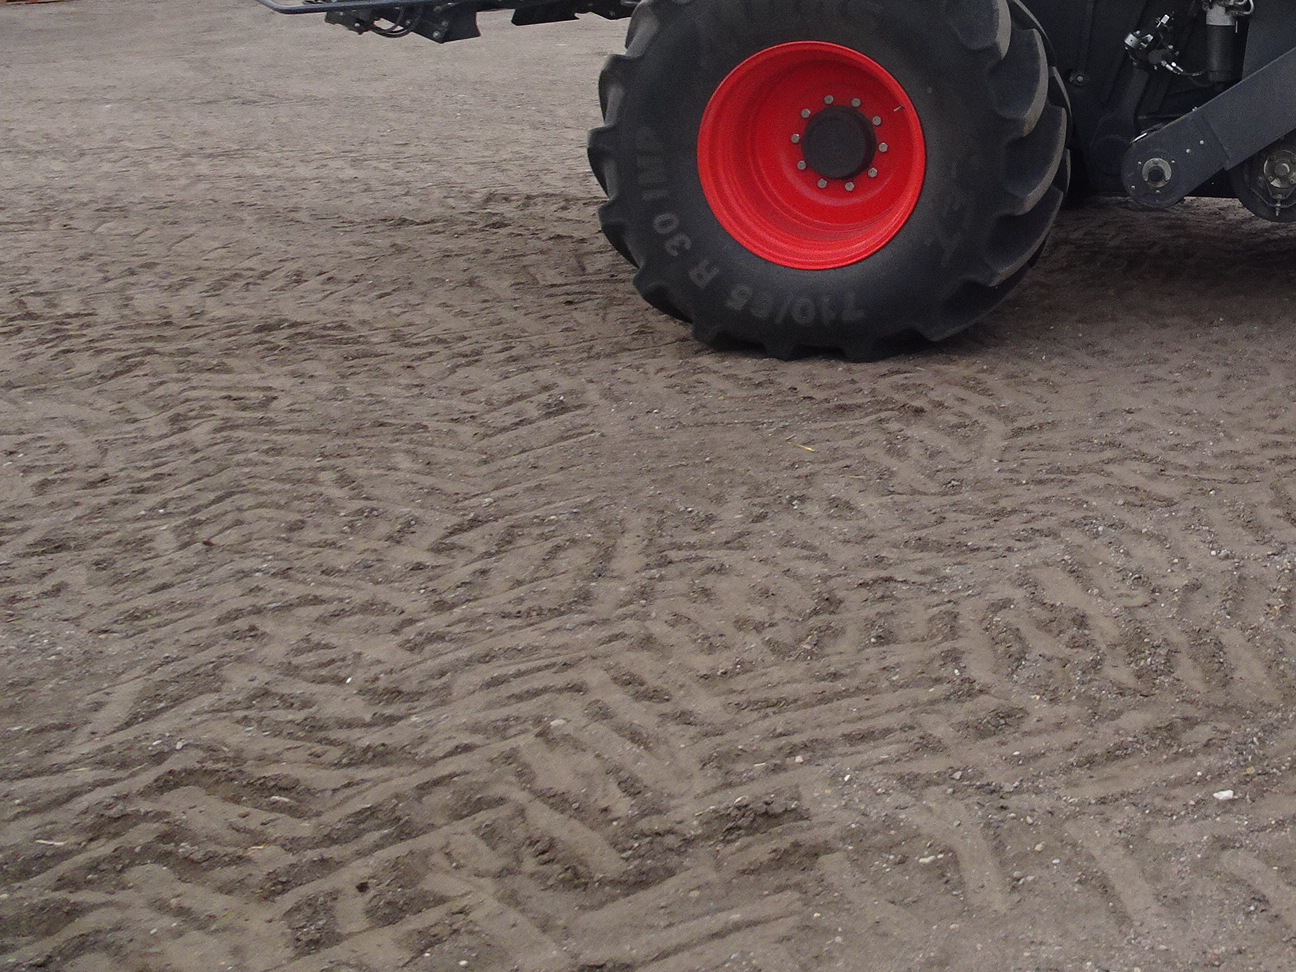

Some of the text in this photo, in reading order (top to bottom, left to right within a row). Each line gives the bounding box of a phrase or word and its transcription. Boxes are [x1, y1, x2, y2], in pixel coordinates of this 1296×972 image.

[652, 212, 692, 258] 30
[688, 262, 719, 291] R
[730, 284, 865, 326] 710/65
